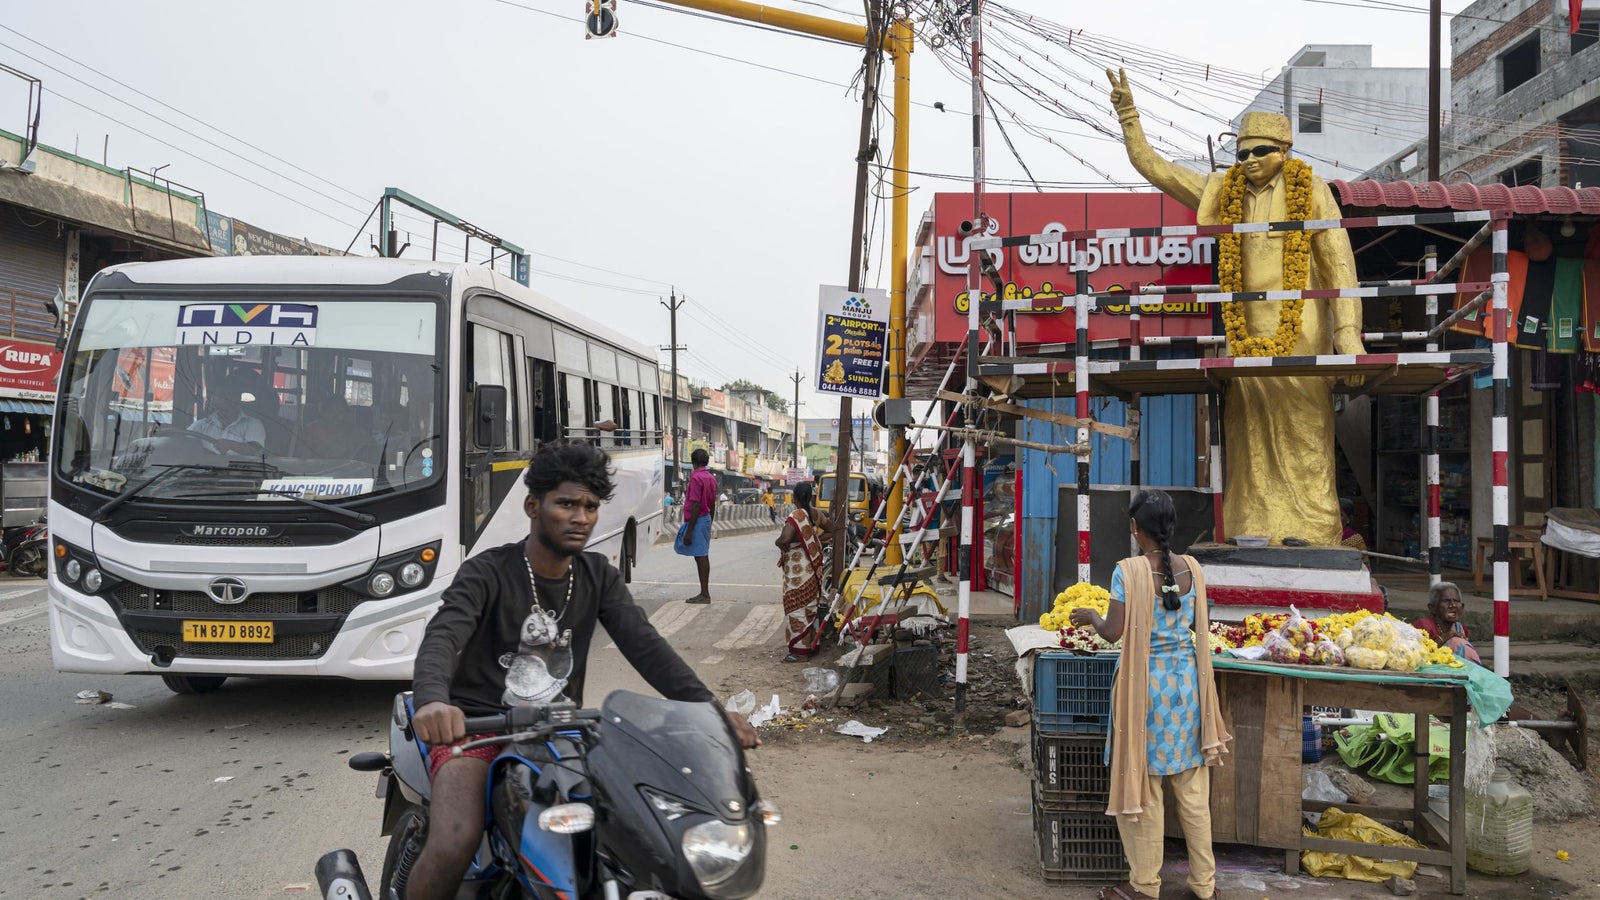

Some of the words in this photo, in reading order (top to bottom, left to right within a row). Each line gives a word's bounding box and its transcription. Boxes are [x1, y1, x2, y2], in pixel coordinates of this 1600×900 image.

[842, 305, 872, 315] MANJU
[840, 319, 878, 331] AIRPORT
[182, 331, 309, 345] INDIA
[825, 333, 843, 356] 2
[5, 350, 51, 367] RUPA
[852, 357, 872, 367] FREE
[847, 374, 880, 384] SUNDAY
[821, 382, 857, 393] 044-6666
[267, 483, 362, 498] KANCHIPURAM
[194, 525, 268, 536] Marcopolo
[192, 624, 207, 638] TN
[210, 624, 226, 638] 87
[229, 625, 236, 638] D
[239, 625, 271, 639] 8892
